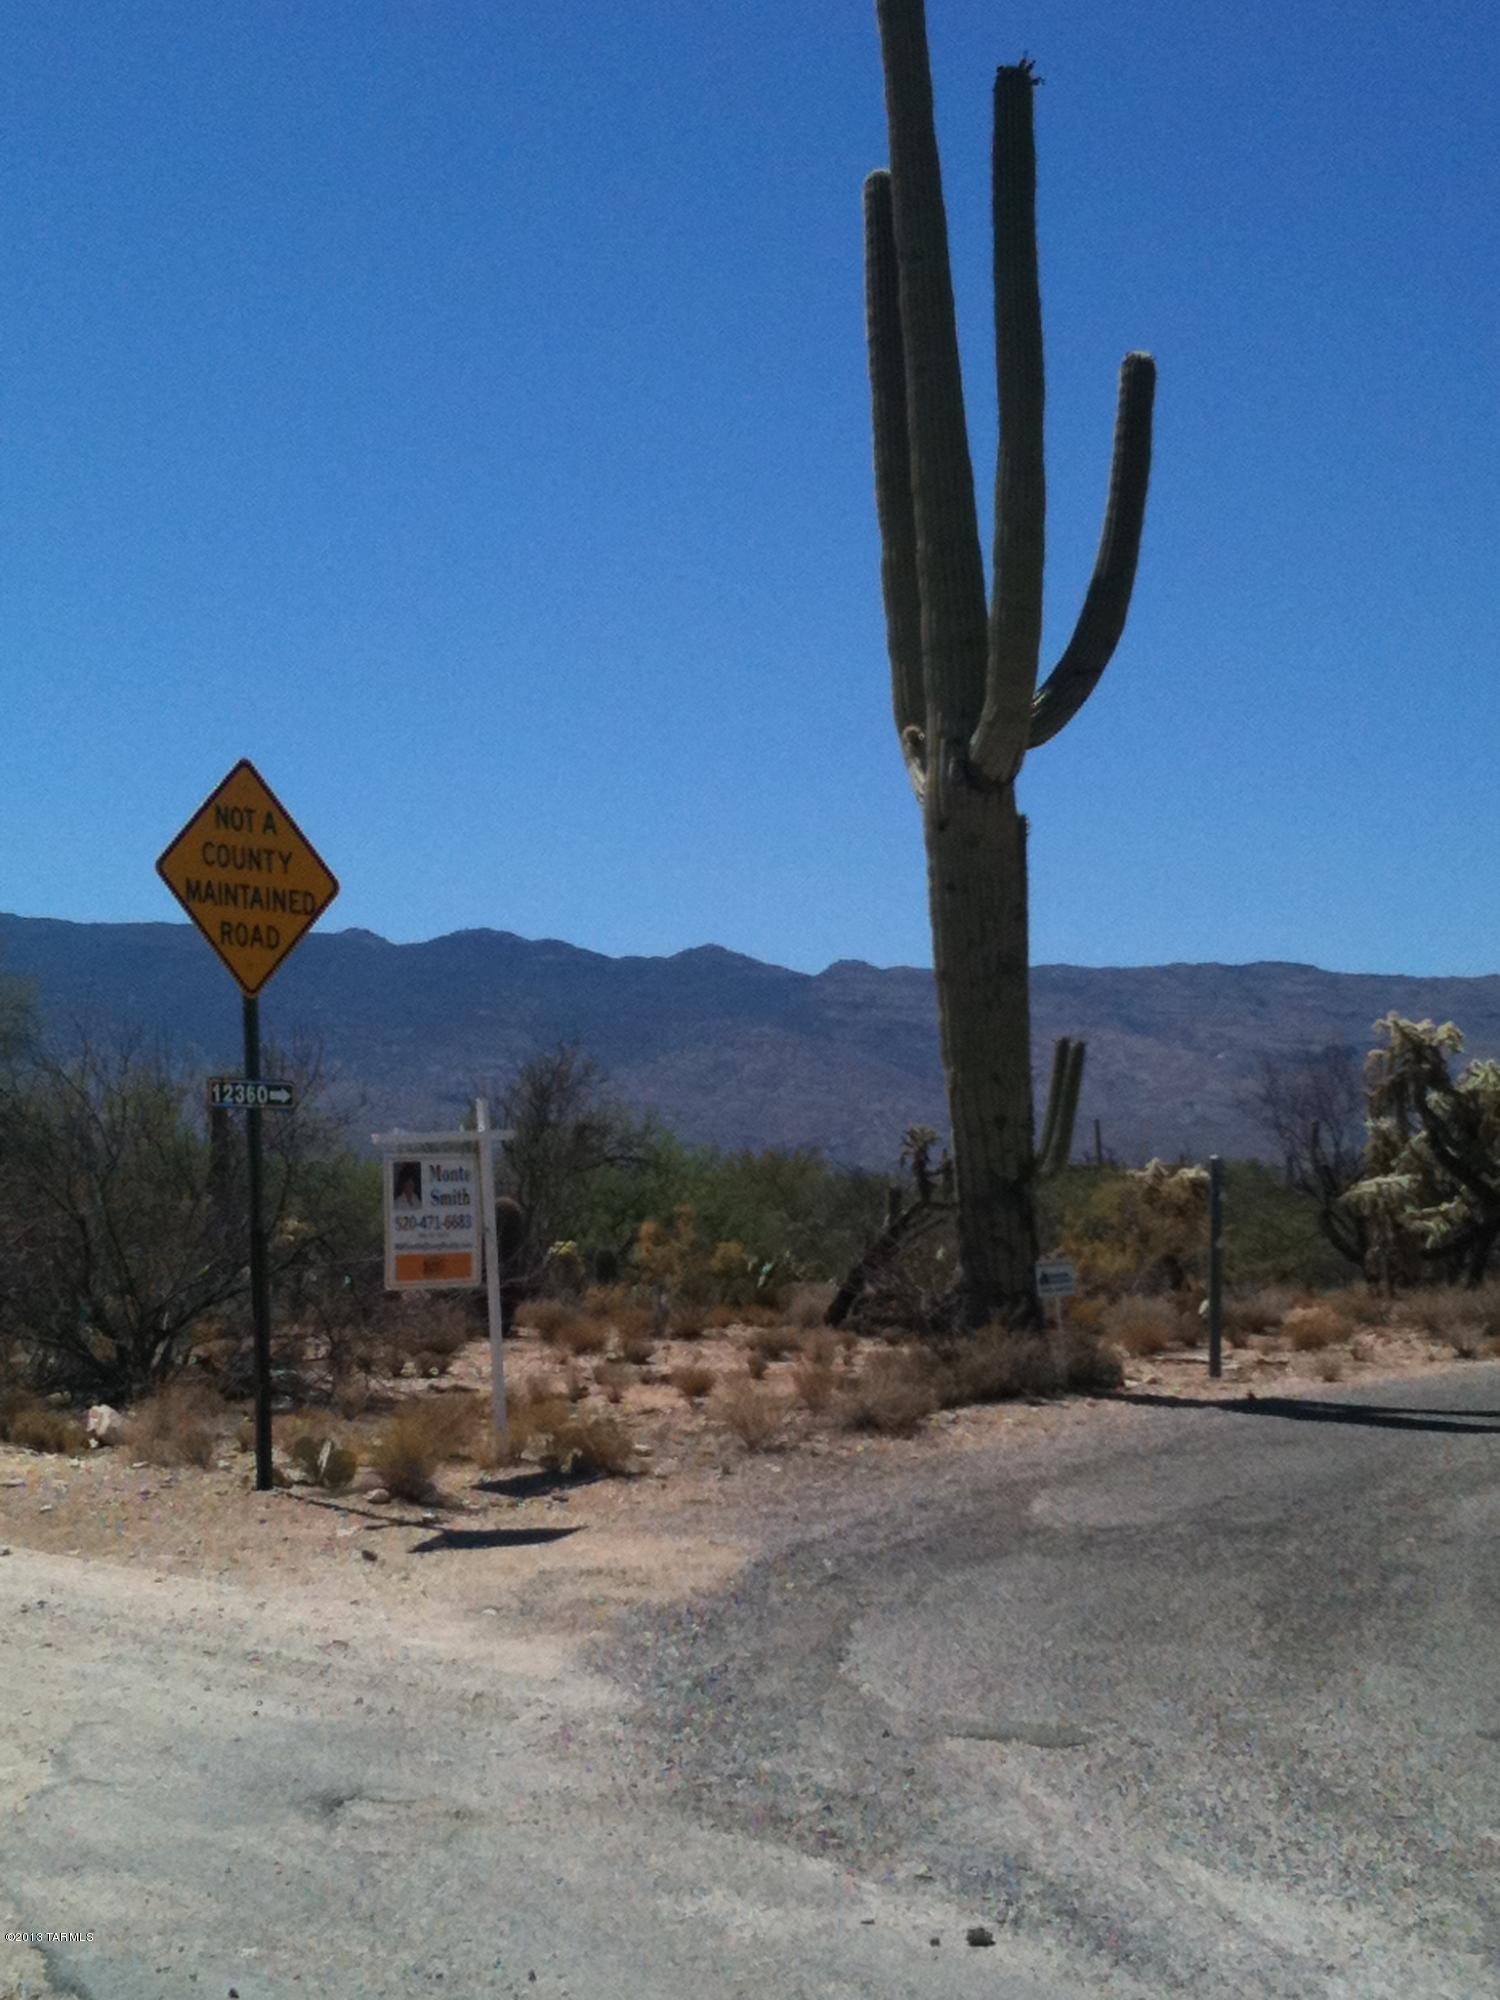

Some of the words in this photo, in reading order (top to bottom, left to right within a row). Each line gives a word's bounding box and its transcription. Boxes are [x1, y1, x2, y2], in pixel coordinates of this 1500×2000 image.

[215, 804, 256, 833] NOT
[263, 811, 277, 835] A
[202, 841, 293, 875] COUNTY
[185, 877, 316, 916] MAINTAINED
[220, 921, 281, 950] ROAD
[212, 1083, 268, 1104] 12360
[430, 1188, 471, 1206] Smith
